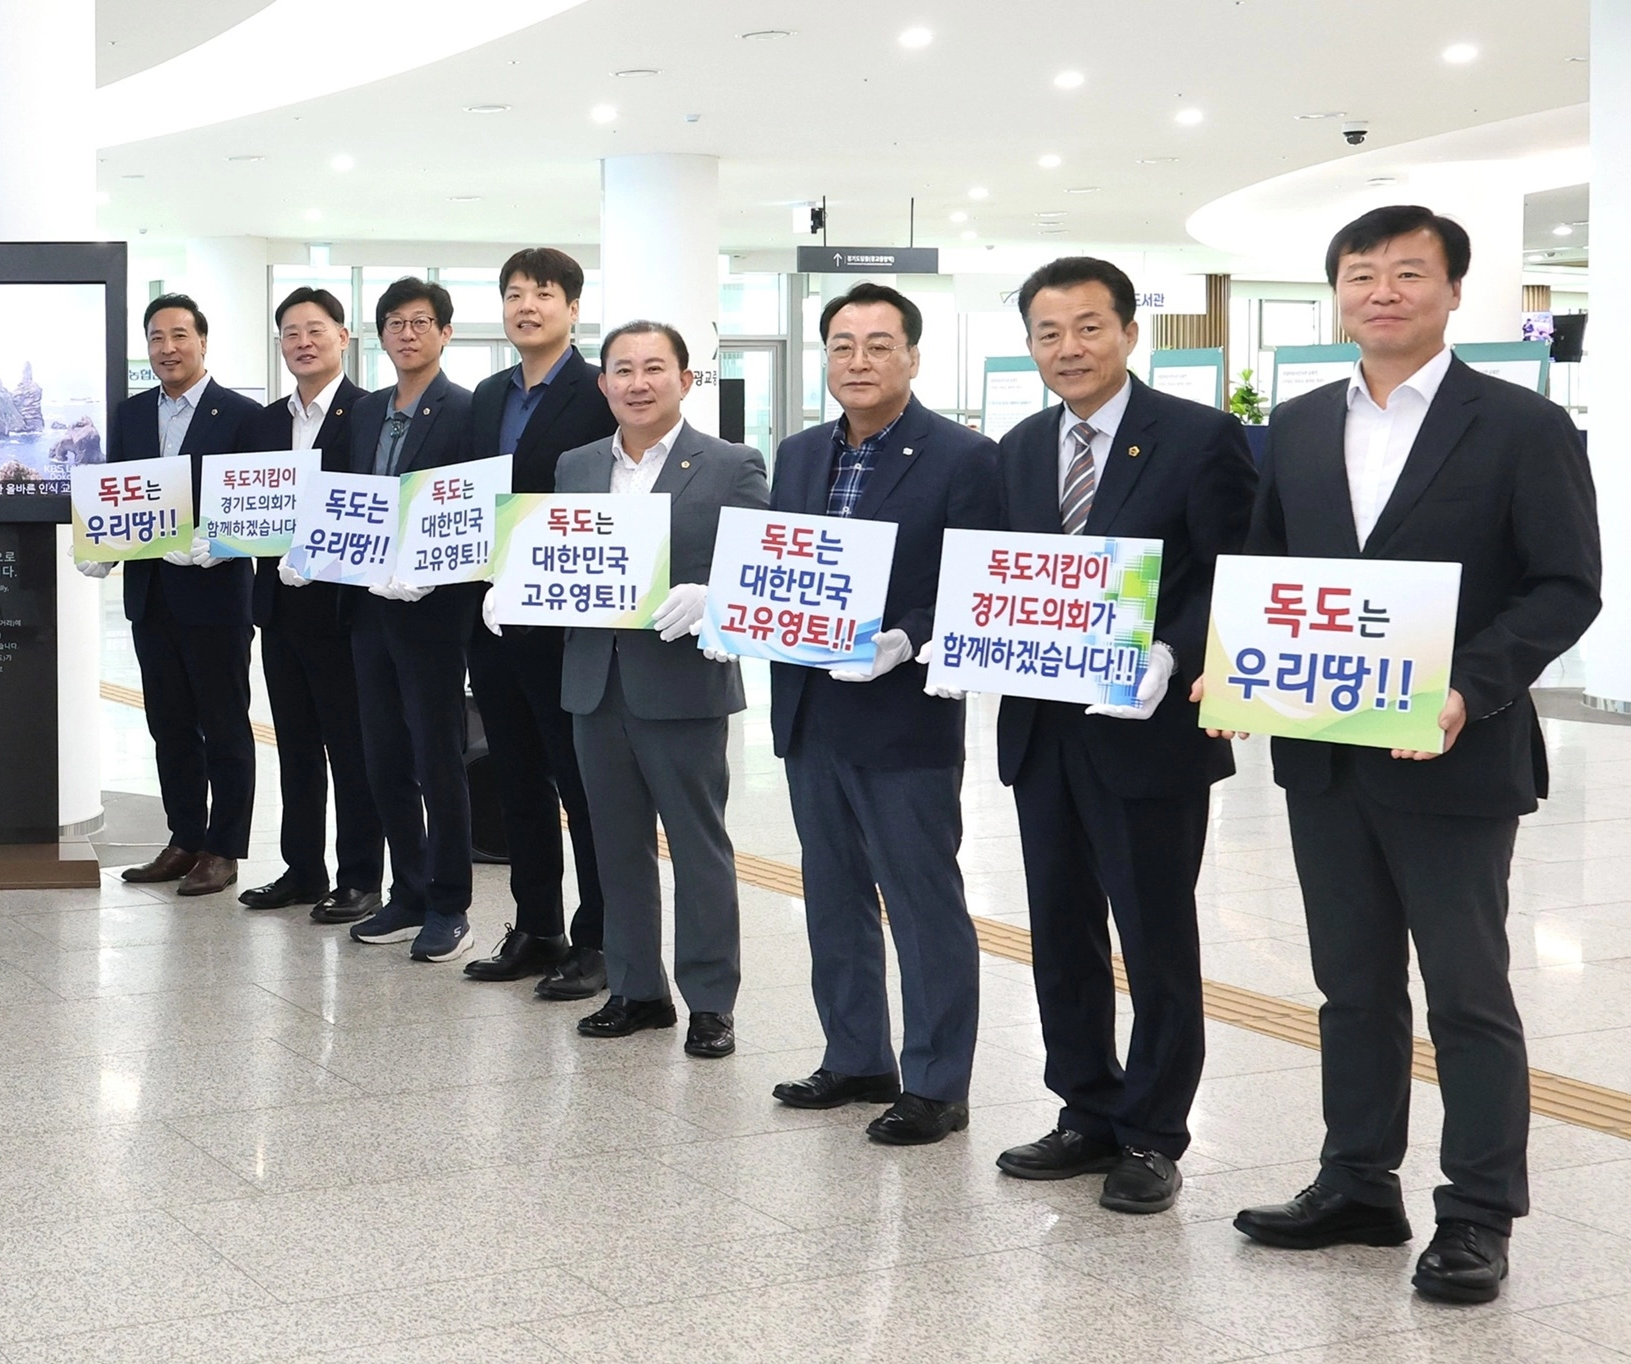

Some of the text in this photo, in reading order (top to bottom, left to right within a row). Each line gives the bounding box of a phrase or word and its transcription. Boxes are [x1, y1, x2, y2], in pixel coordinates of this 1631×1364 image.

[6, 484, 35, 494] 올바른
[39, 483, 58, 494] 인식
[99, 476, 161, 507] 독도는
[223, 468, 296, 490] 독도지킴이
[432, 479, 474, 505] 독도는
[221, 495, 296, 514] 경기도의회가
[326, 489, 388, 523] 독도는
[86, 509, 177, 544] 우리땅!!
[422, 508, 483, 538] 대한민국
[548, 508, 614, 536] 독도는
[305, 529, 390, 565] 우리땅!!
[415, 541, 488, 571] 고유영토!!
[532, 545, 628, 574] 대한민국
[761, 524, 843, 565] 독도는
[988, 550, 1108, 589] 독도지킴이
[522, 583, 636, 612] 고유영토!!
[740, 564, 852, 610] 대한민국
[721, 604, 856, 651] 고유영토!!
[972, 593, 1116, 634] 경기도의회가
[1264, 583, 1390, 638] 독도는
[944, 632, 1135, 682] 함께하겠습니다!!
[1228, 648, 1412, 712] 우리땅!!
